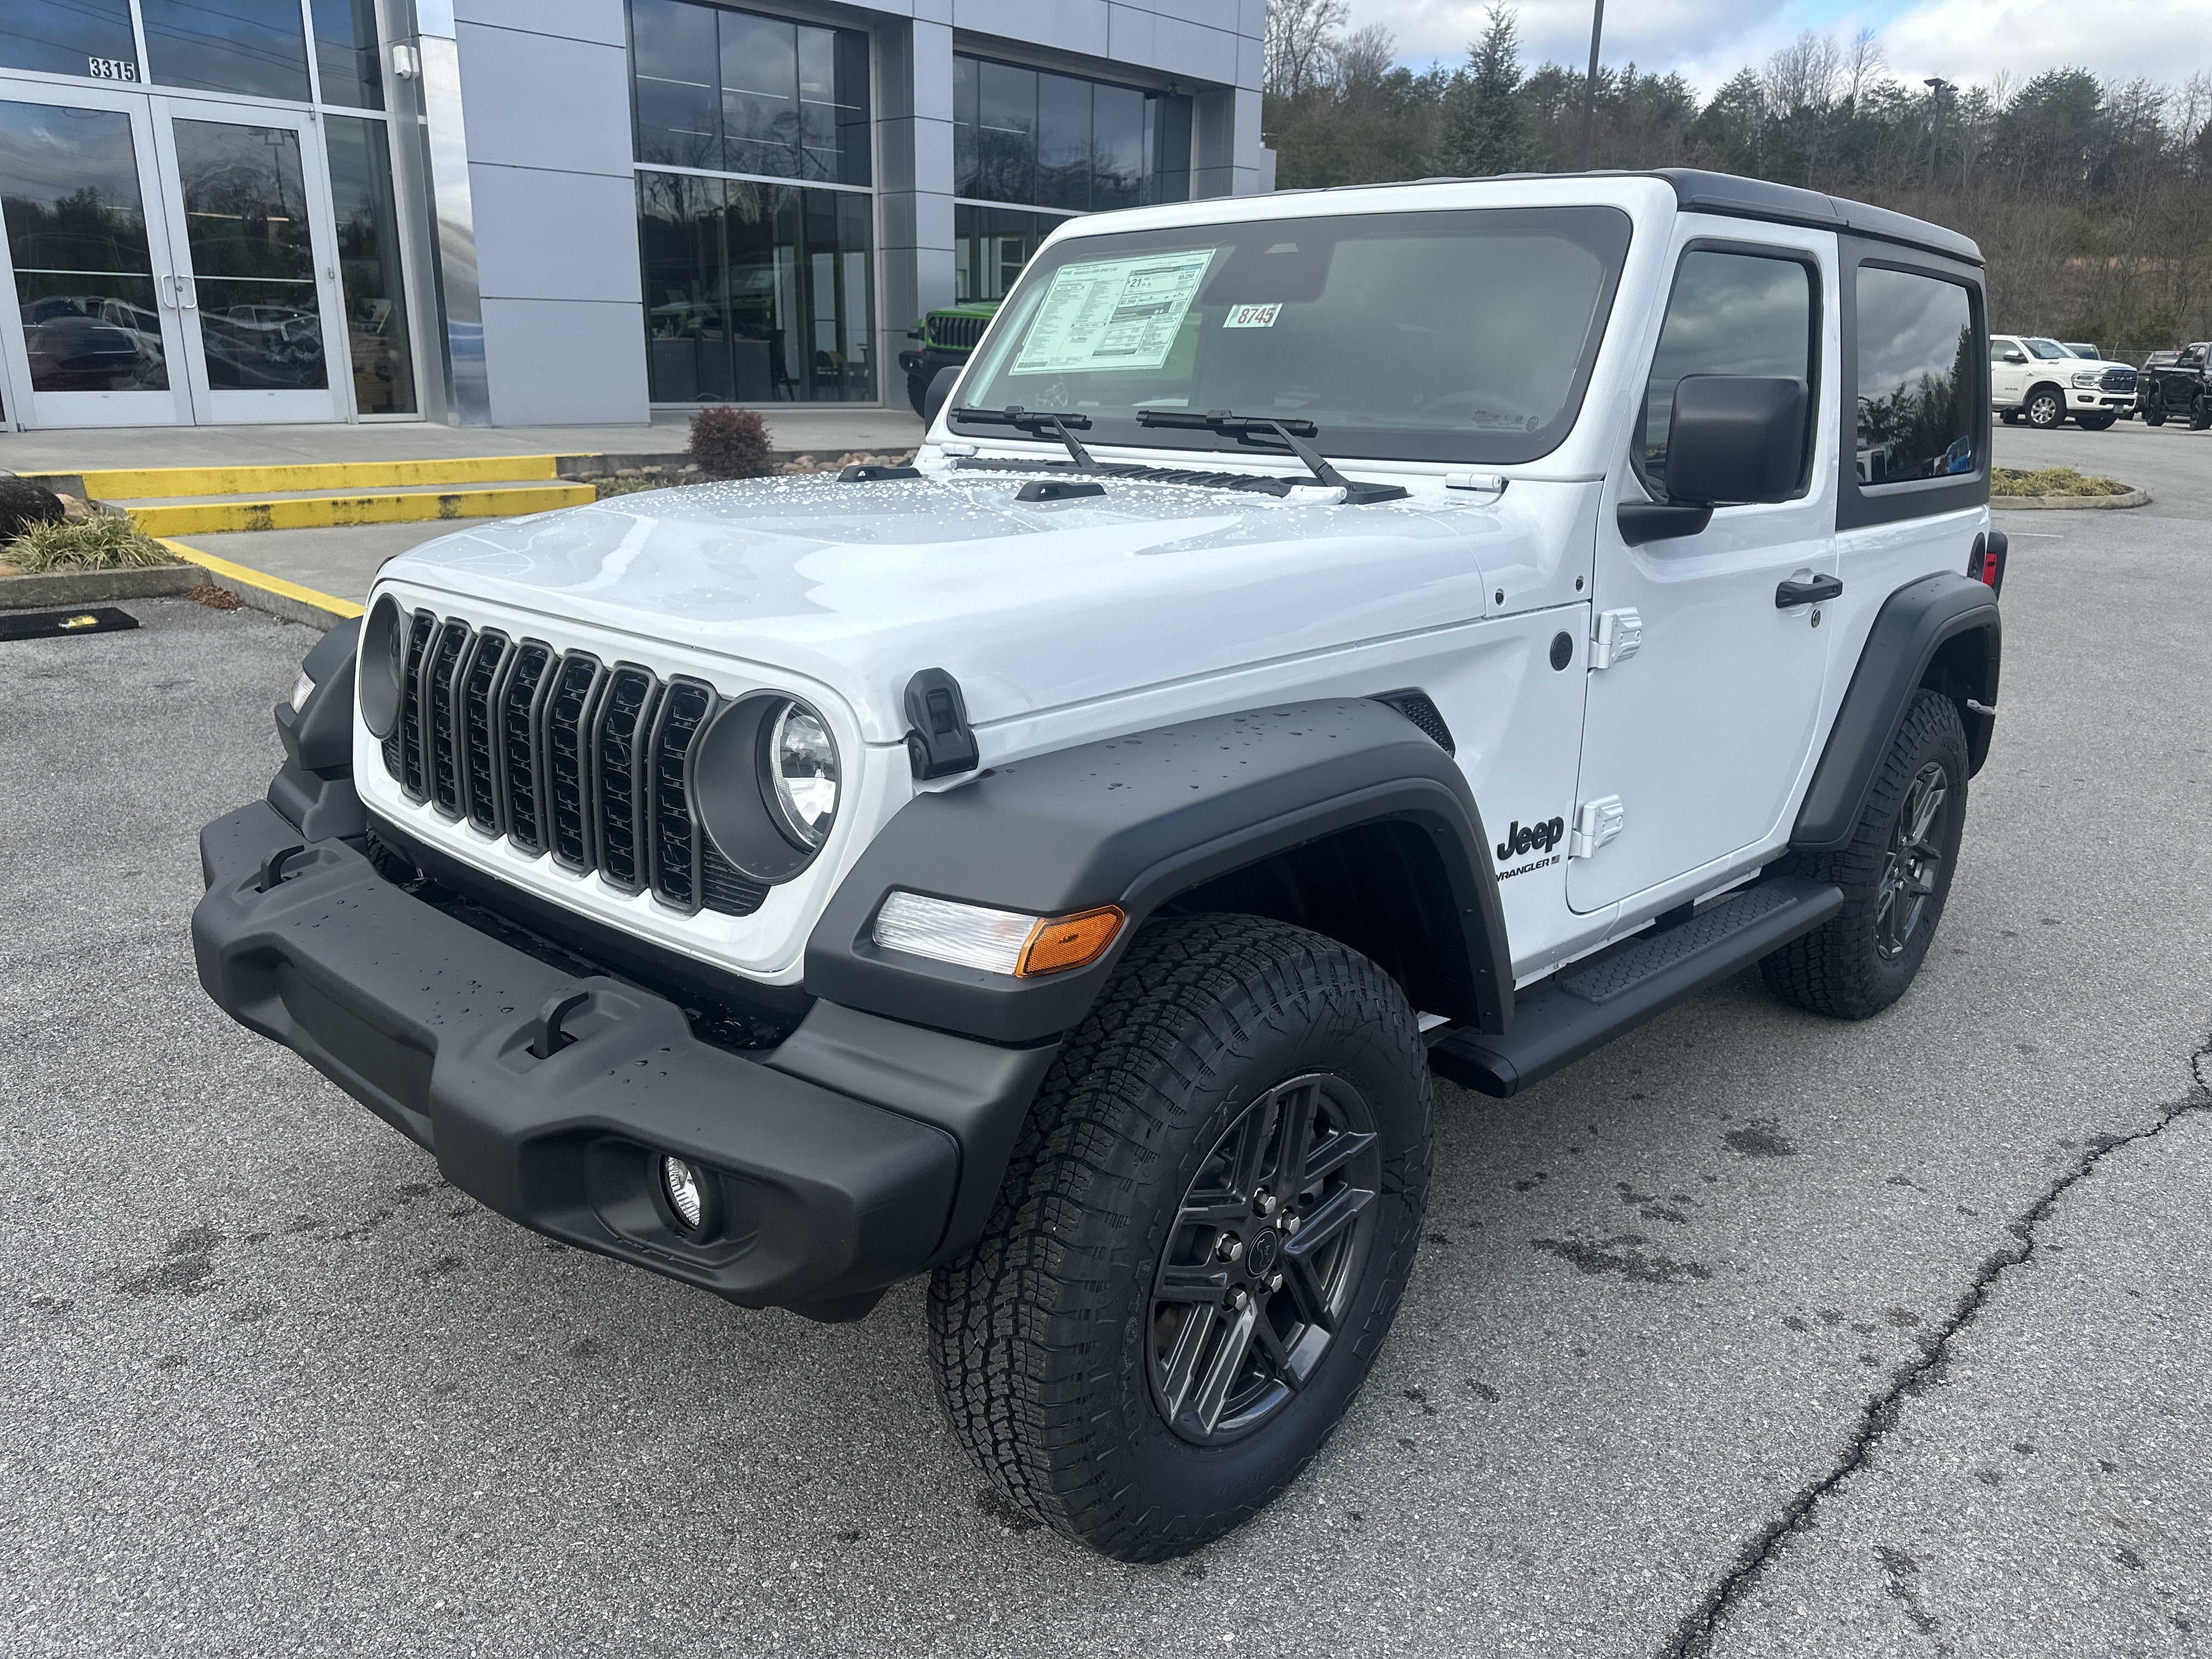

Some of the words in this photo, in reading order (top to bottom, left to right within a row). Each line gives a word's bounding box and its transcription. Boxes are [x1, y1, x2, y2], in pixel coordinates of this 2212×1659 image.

[91, 58, 134, 81] 3315
[1130, 278, 1142, 287] 21
[1237, 307, 1276, 324] 8745
[1497, 816, 1564, 861] Jeep
